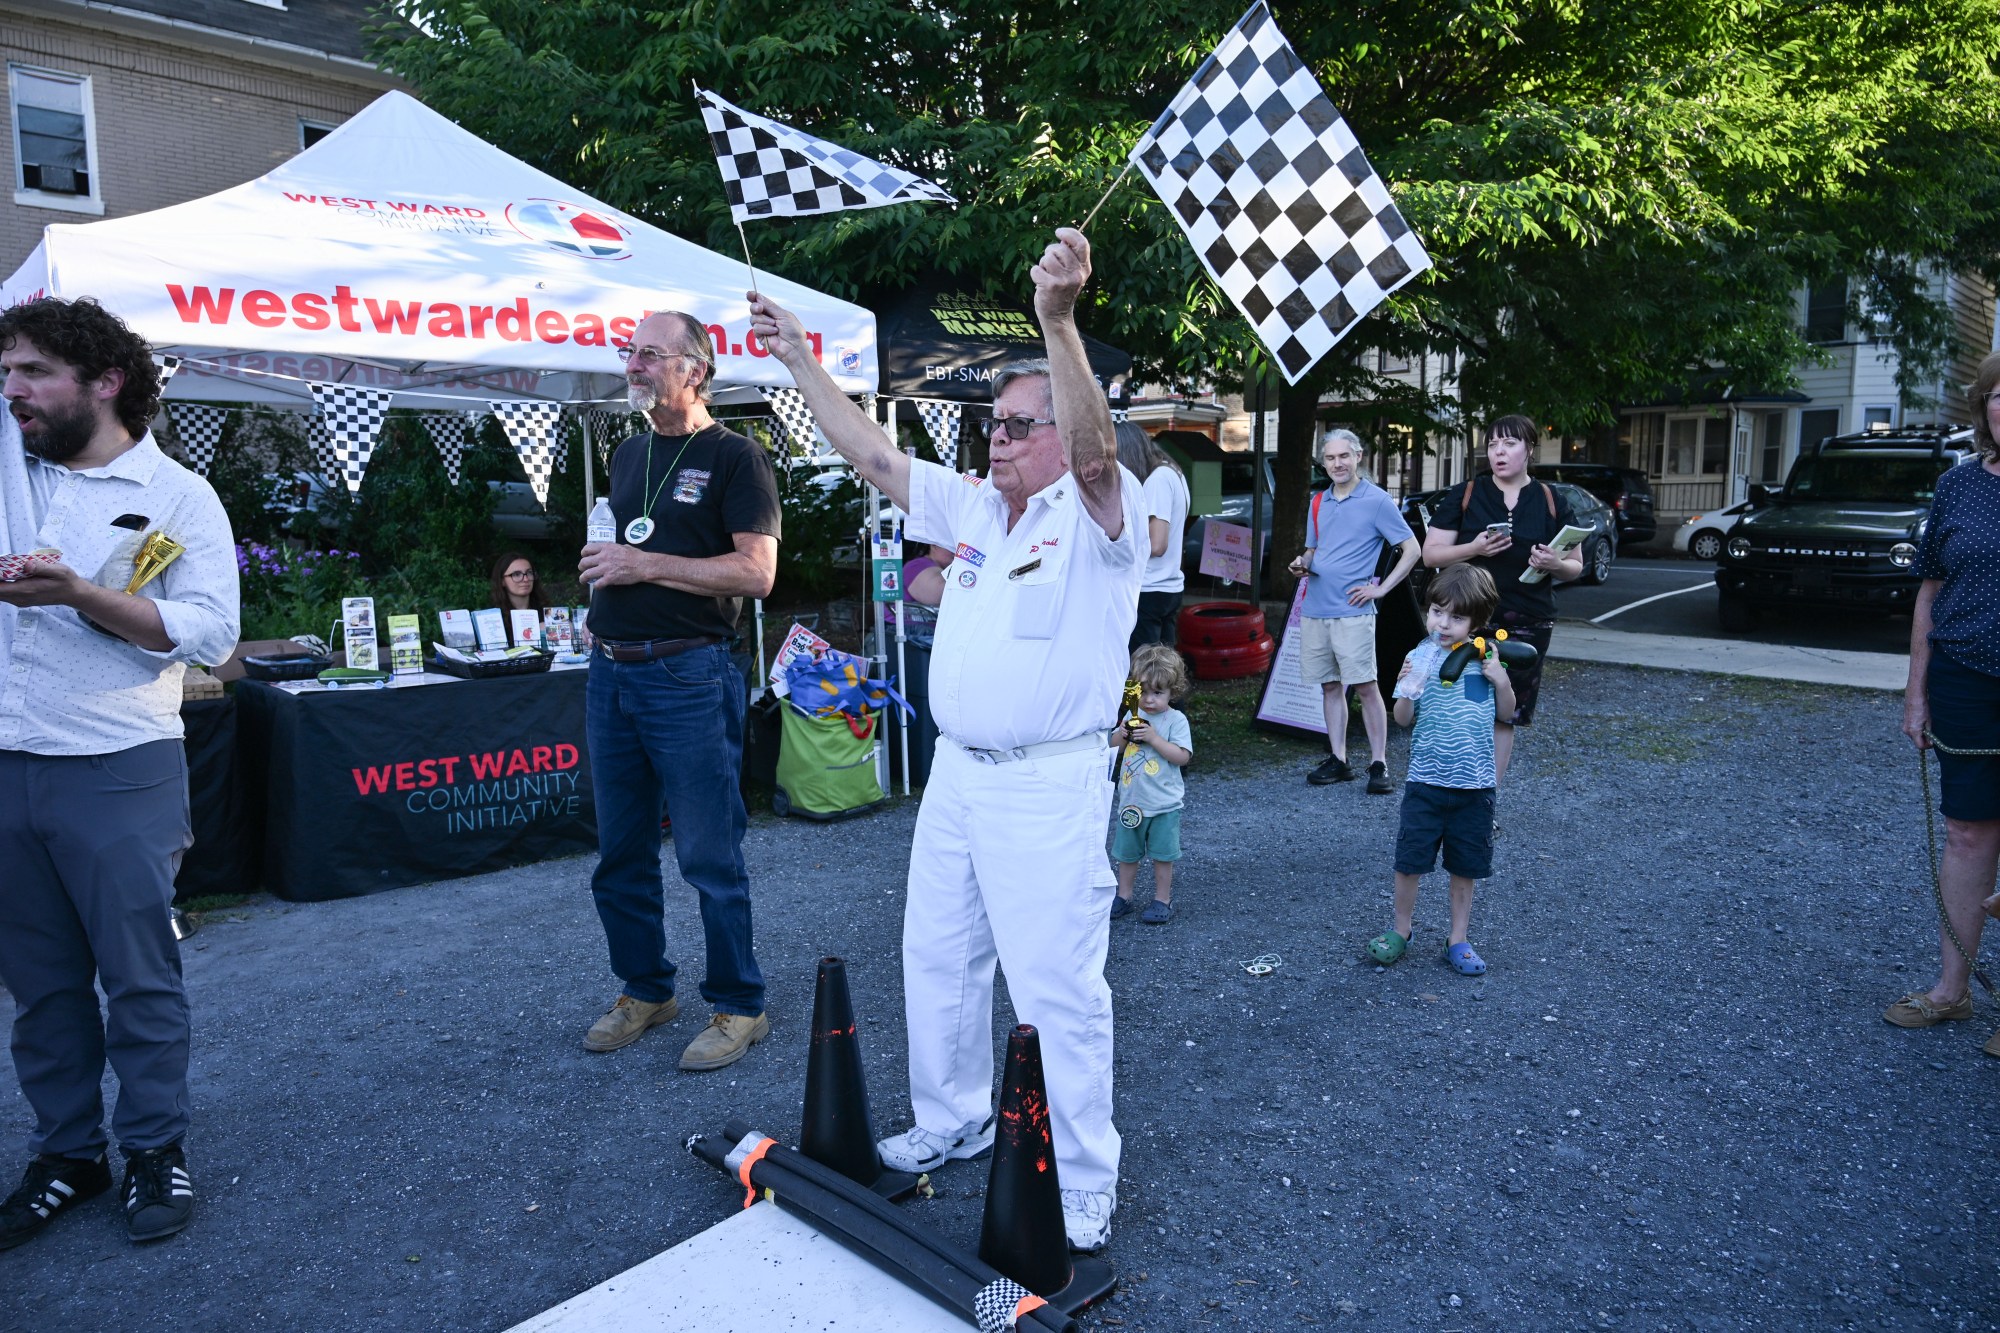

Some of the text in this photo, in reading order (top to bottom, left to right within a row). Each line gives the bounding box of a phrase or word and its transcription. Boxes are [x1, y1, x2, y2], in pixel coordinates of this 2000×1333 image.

[283, 191, 487, 219] WEST WARD
[336, 207, 491, 228] COMMUNITY
[377, 218, 504, 239] INITIATIVE
[165, 283, 822, 366] westwardeasn.o
[929, 308, 1028, 323] WEST WARD
[940, 319, 1041, 339] MARKET
[957, 544, 987, 568] NASCAR
[1235, 553, 1251, 562] LOCALE
[1767, 547, 1866, 557] BRONCO
[791, 637, 806, 653] Bag
[352, 743, 579, 796] WEST WARD
[406, 770, 580, 814] COMMUNITY
[447, 795, 580, 834] INITIATIVE
